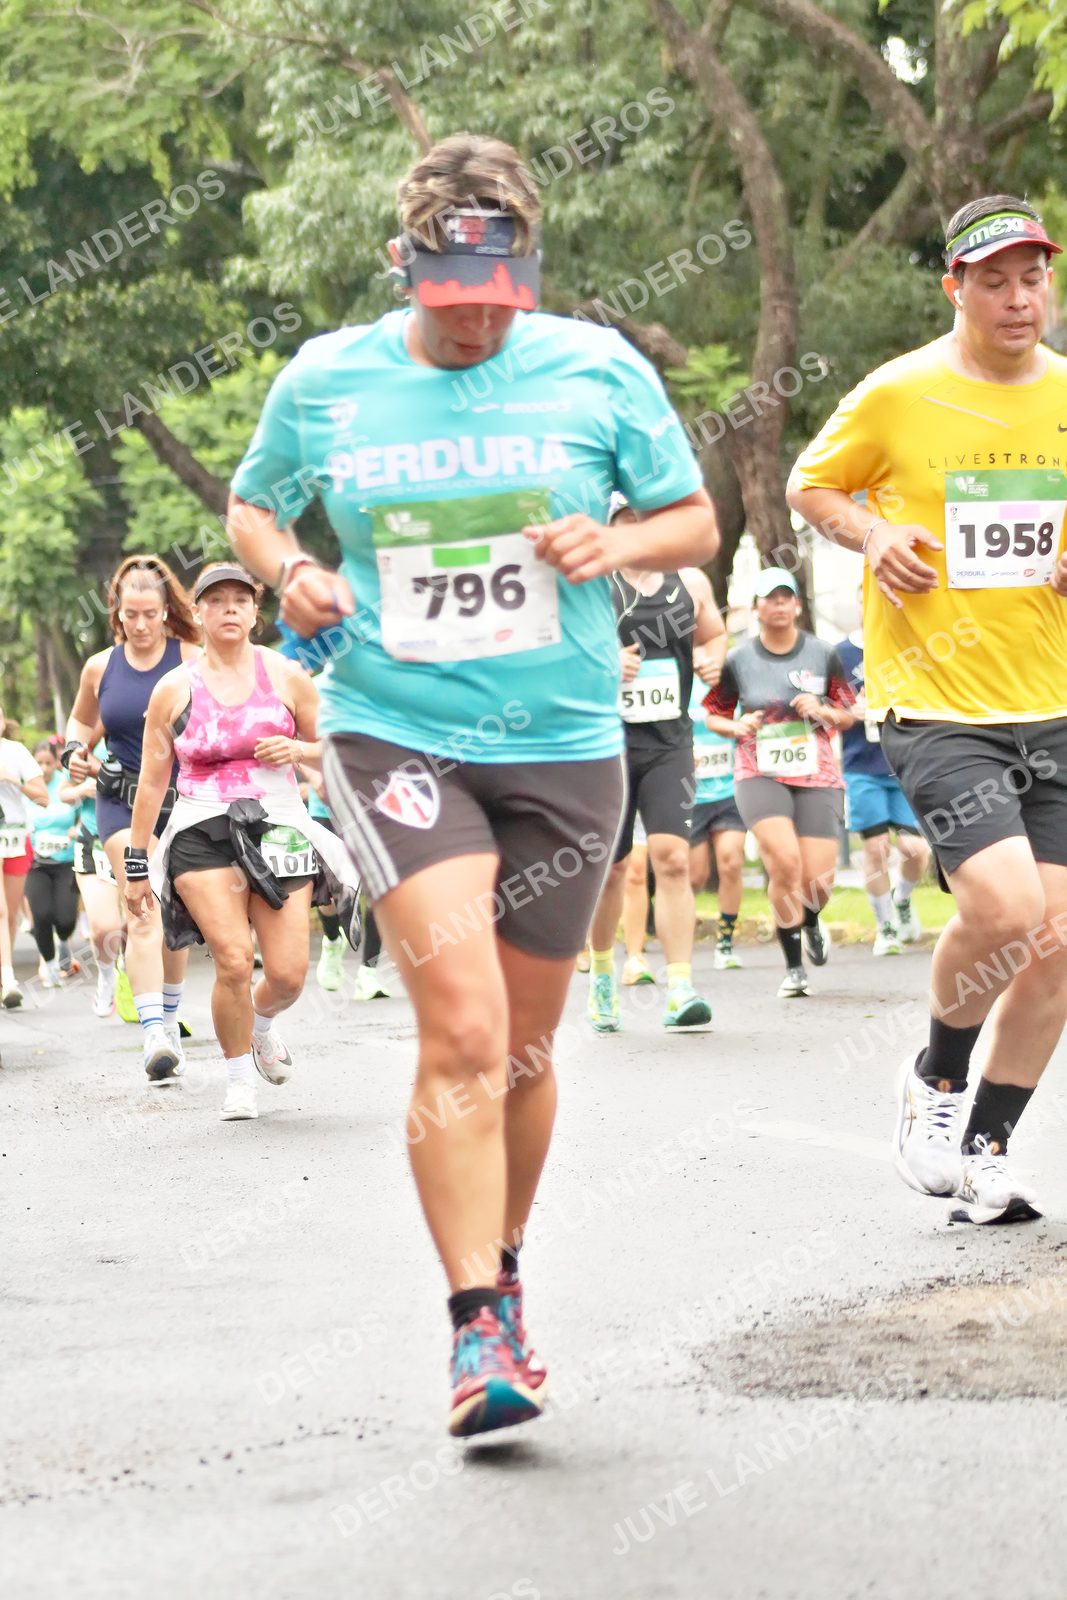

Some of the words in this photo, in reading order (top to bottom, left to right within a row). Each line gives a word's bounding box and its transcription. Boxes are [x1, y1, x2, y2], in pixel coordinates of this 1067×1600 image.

[329, 433, 572, 494] PERDURA
[928, 452, 1067, 468] LIVESTRON
[959, 521, 1054, 559] 1958
[412, 563, 526, 620] 796
[622, 687, 675, 708] 5104
[769, 747, 807, 764] 706
